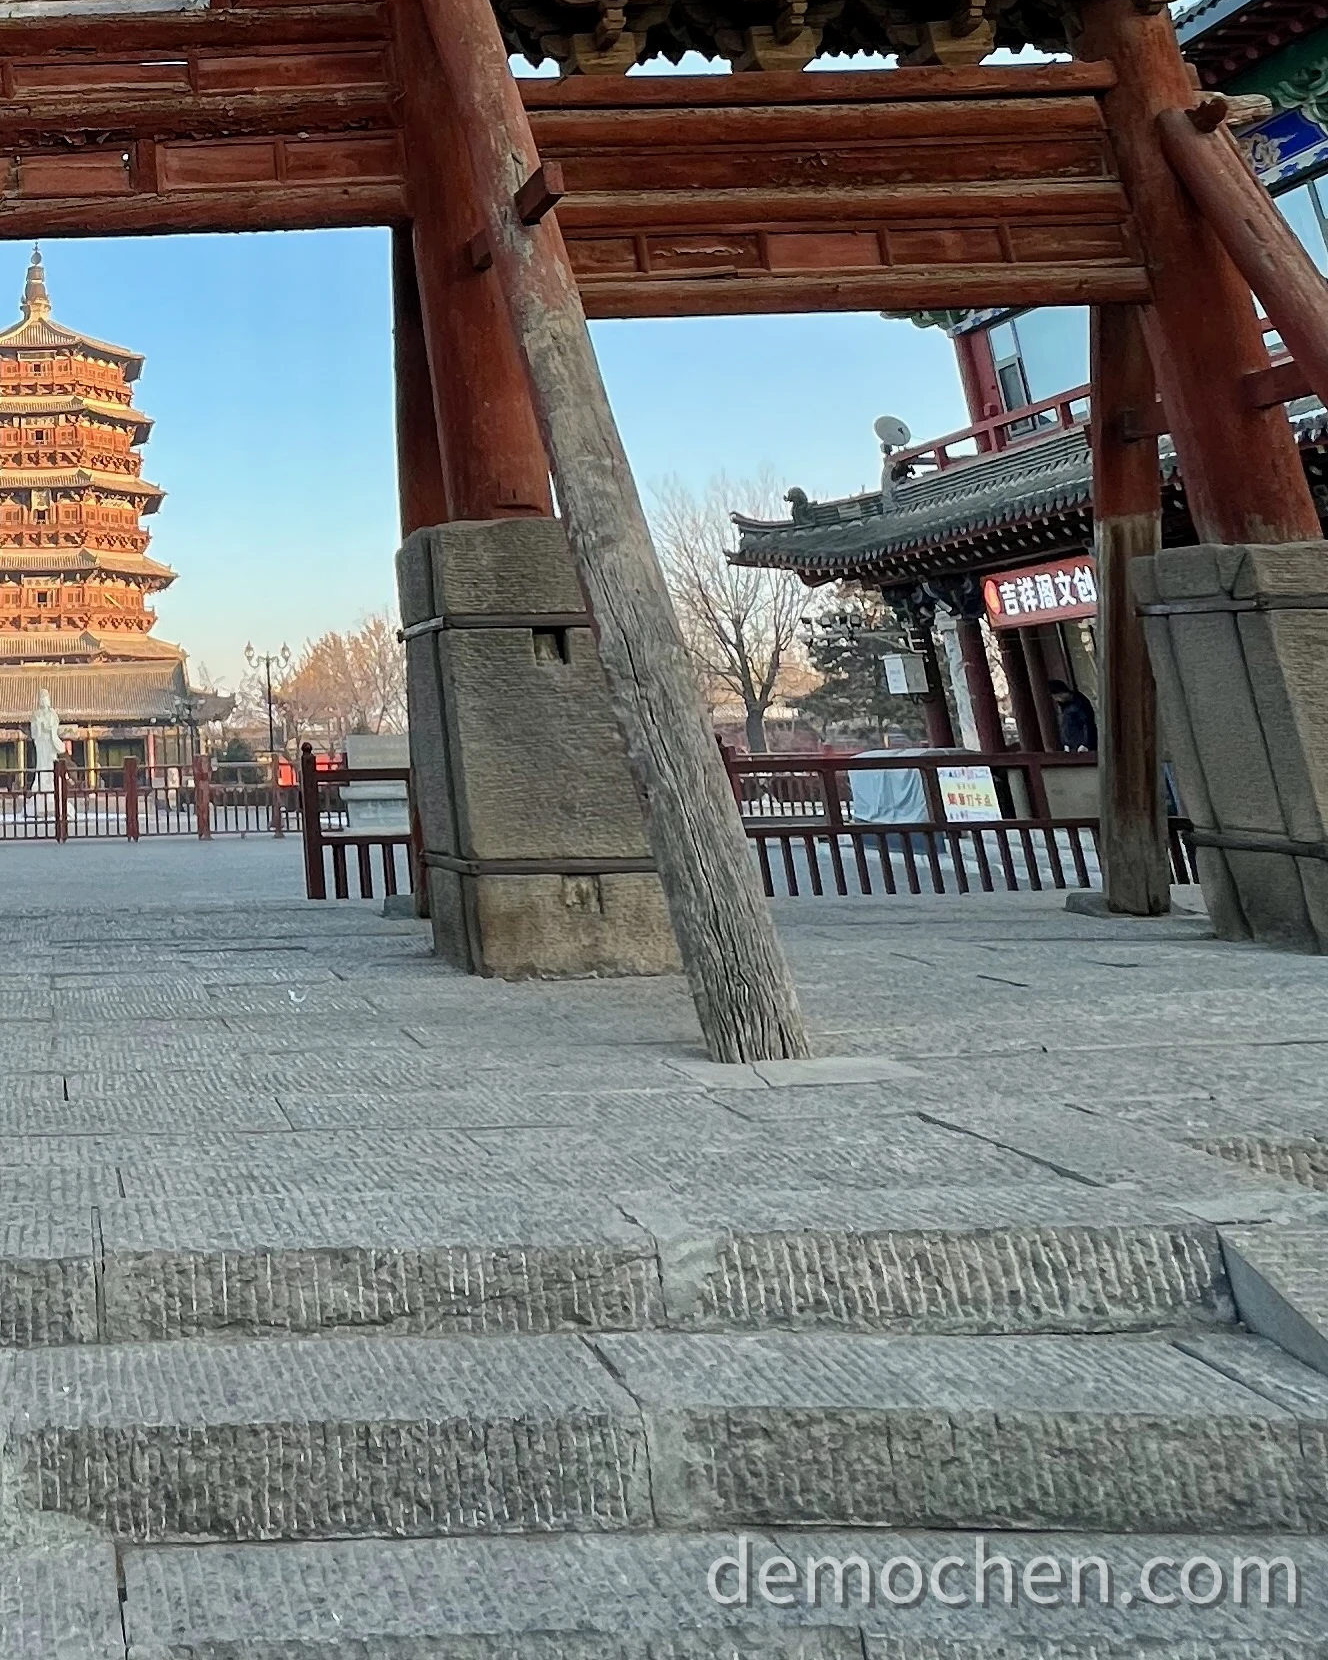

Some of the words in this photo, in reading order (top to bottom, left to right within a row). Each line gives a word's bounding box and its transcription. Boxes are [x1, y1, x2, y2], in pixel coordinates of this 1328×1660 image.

[999, 565, 1097, 615] 吉祥阁文创
